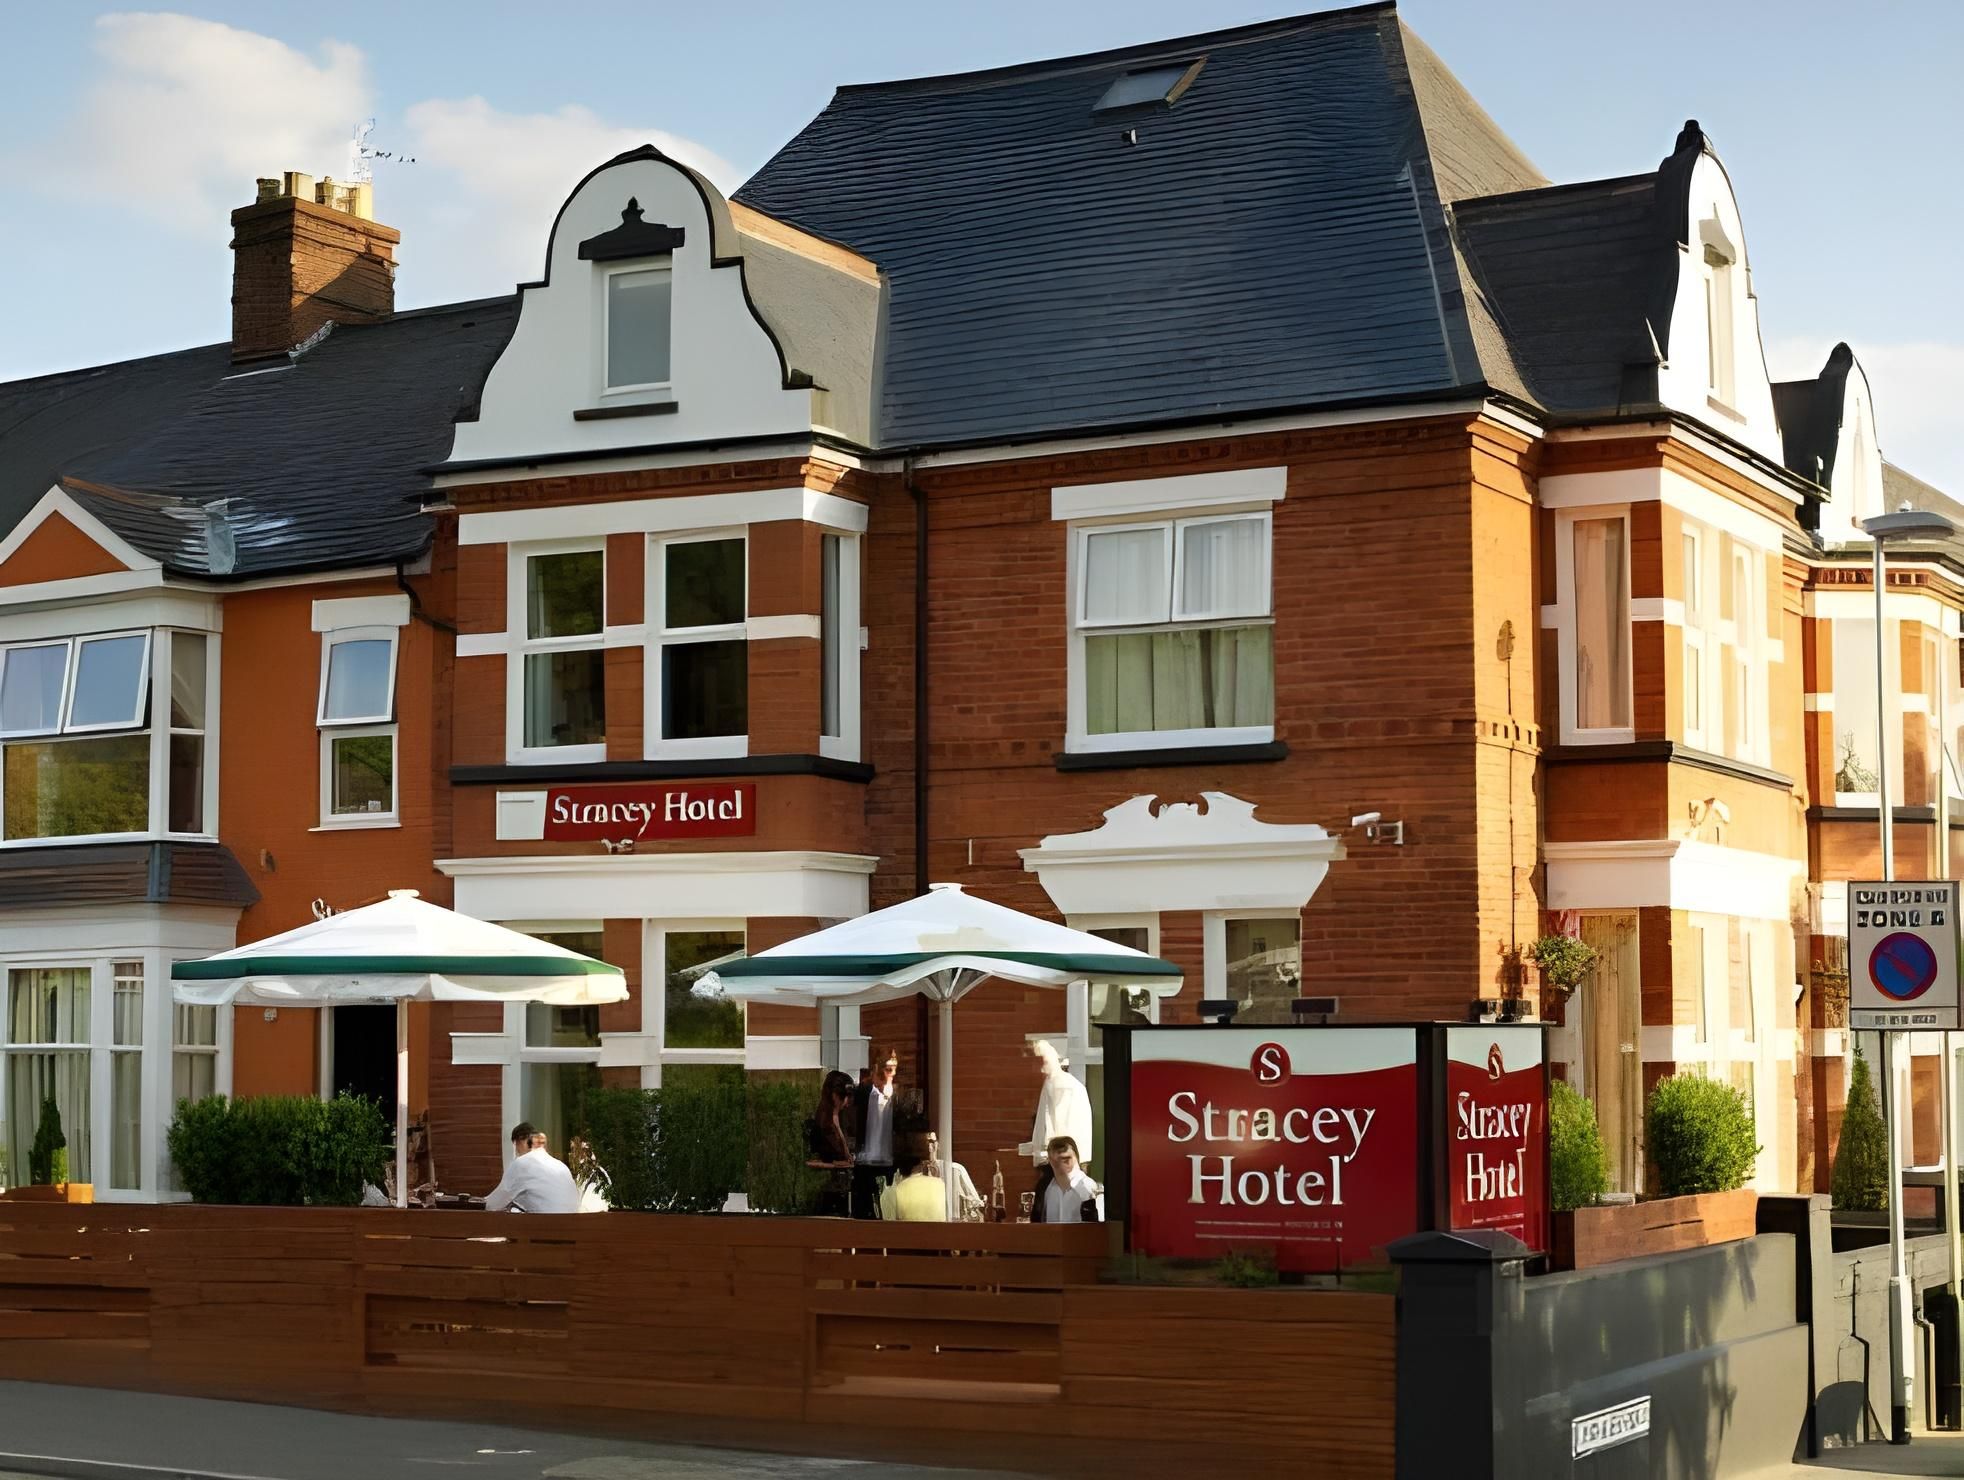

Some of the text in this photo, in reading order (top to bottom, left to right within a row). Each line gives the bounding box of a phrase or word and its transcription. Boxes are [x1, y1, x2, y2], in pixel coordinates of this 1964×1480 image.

[664, 789, 742, 821] Hotel
[1258, 1047, 1282, 1081] S
[1167, 1091, 1376, 1163] Stracey
[1456, 1091, 1532, 1151] Stracey
[1186, 1154, 1344, 1206] Hotel
[1466, 1150, 1525, 1202] Hotel
